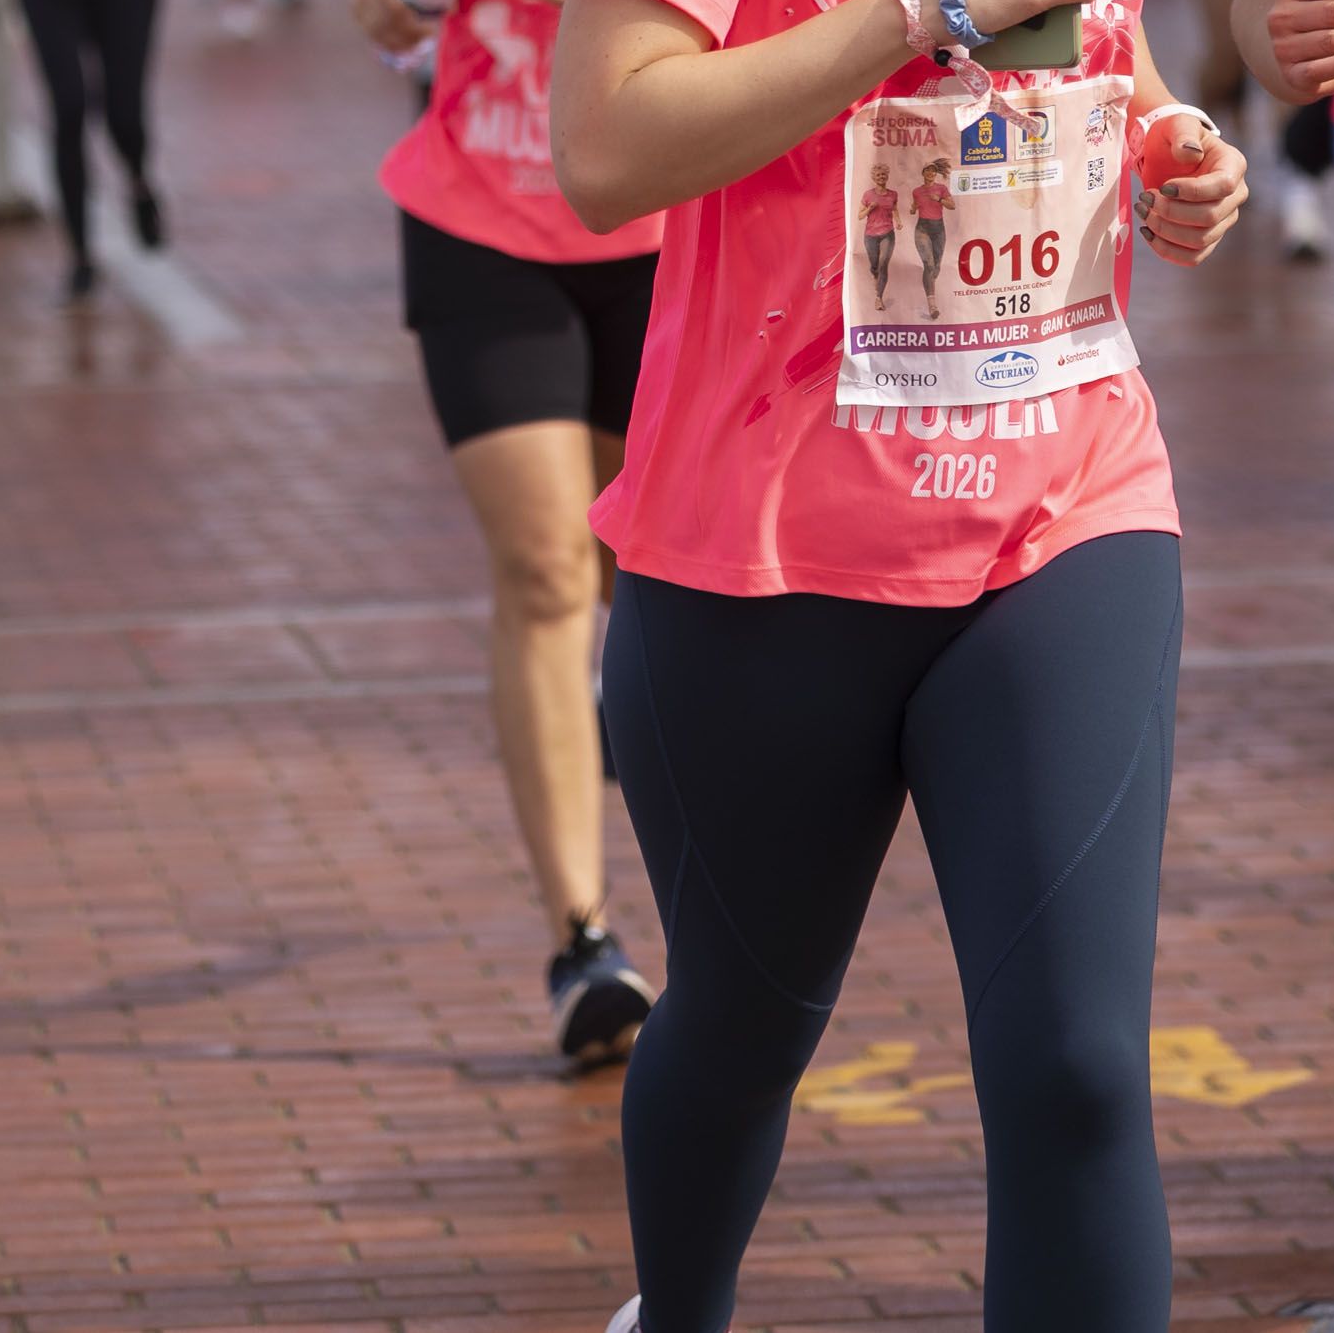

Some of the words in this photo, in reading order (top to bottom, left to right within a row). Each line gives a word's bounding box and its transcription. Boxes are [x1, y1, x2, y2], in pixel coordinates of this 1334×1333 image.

[888, 117, 938, 128] DORSAL
[873, 129, 938, 147] SUMA
[965, 154, 981, 162] Gran
[981, 153, 1004, 162] Canaria
[968, 147, 992, 155] Cabildo
[957, 230, 1060, 286] 016
[989, 284, 1022, 294] VIOLENCIA
[1022, 282, 1031, 290] DE
[995, 293, 1031, 316] 518
[856, 331, 928, 348] CARRERA
[937, 331, 954, 347] DE
[960, 331, 978, 346] LA
[983, 326, 1029, 345] MUJER
[1041, 315, 1064, 336] GRAN
[1064, 303, 1106, 329] CANARIA
[1065, 348, 1100, 364] Santander
[875, 372, 938, 387] OYSHO
[980, 365, 1035, 382] ASTURIANA
[911, 453, 997, 500] 2026
